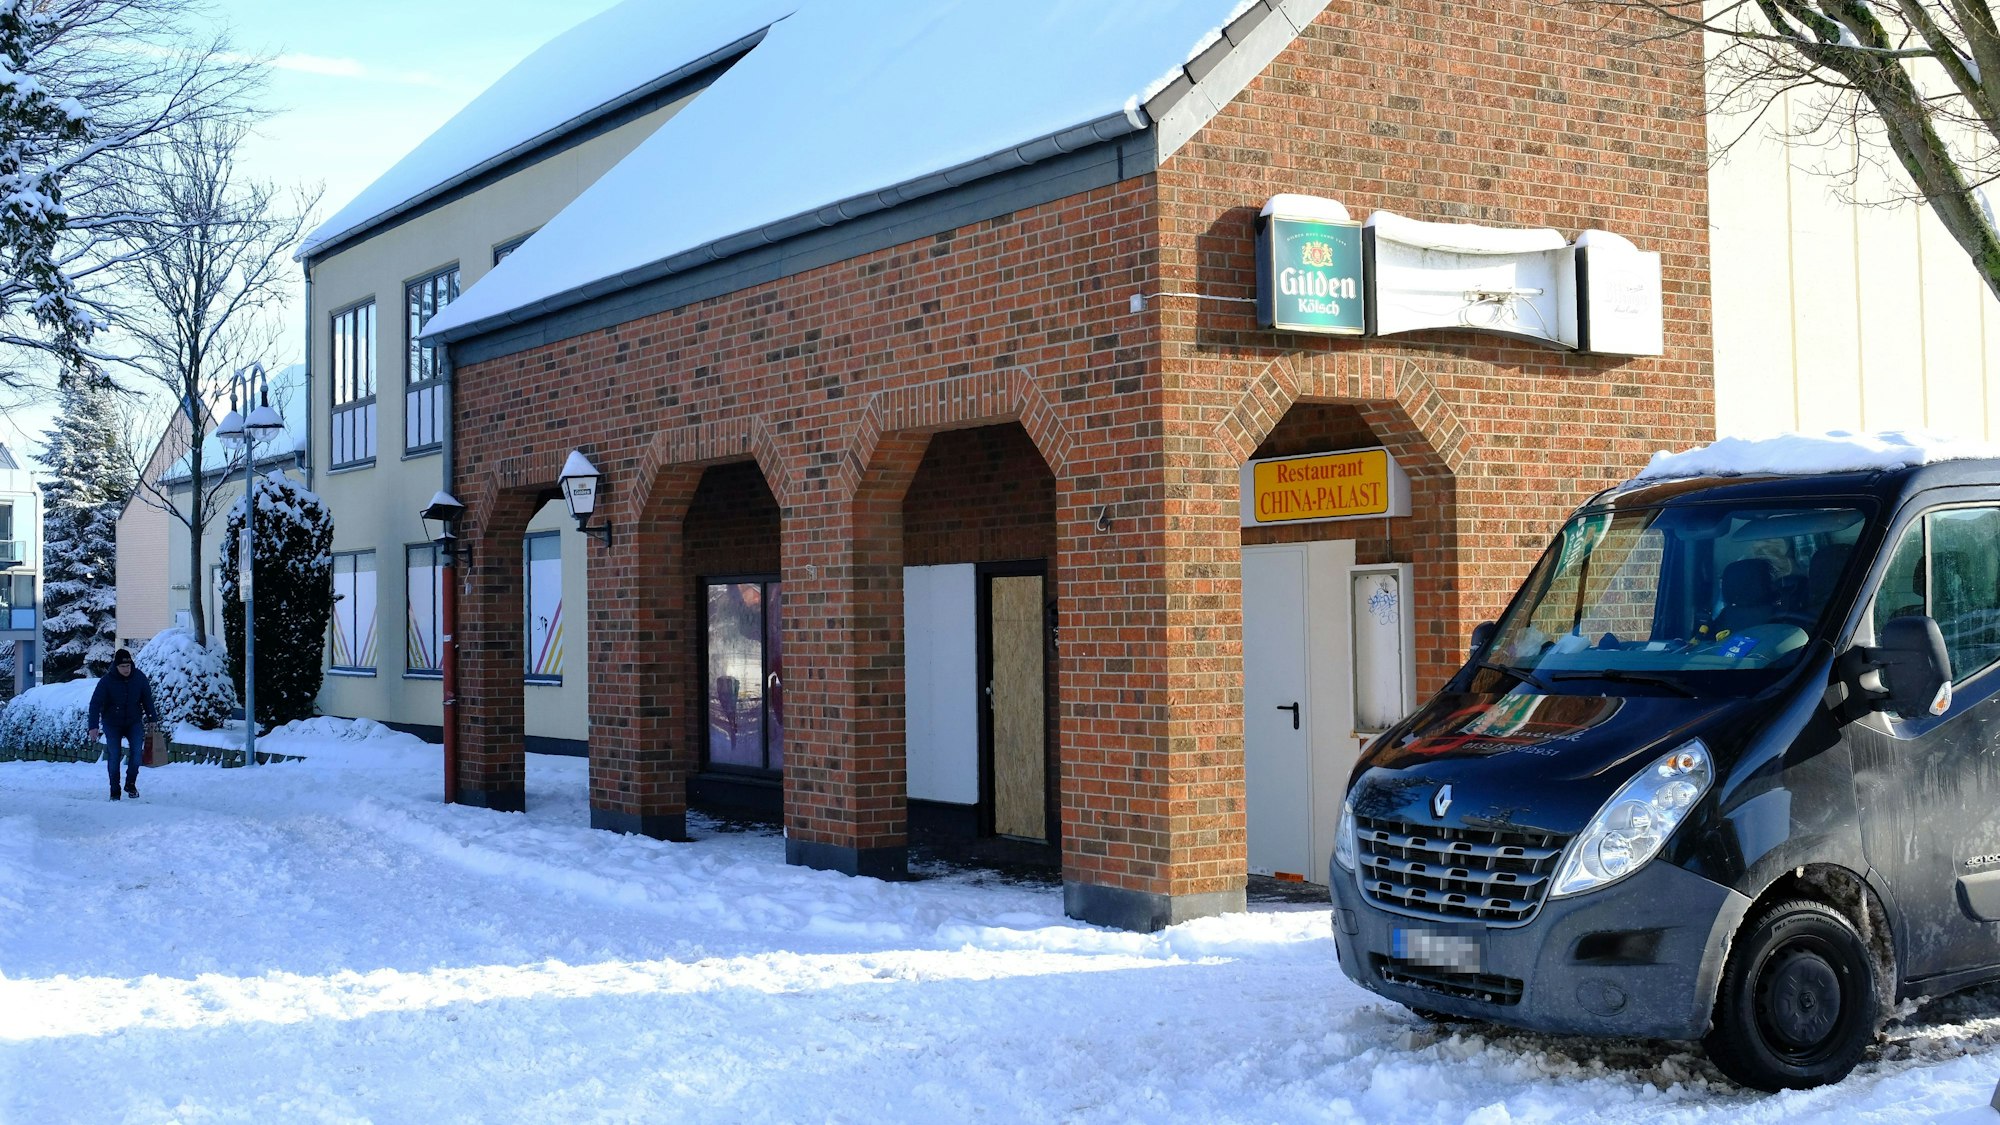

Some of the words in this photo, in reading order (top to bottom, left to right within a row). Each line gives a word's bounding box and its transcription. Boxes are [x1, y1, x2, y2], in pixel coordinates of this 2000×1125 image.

[1280, 267, 1356, 299] Gilden
[1298, 298, 1340, 316] Kölsch
[1276, 456, 1364, 484] Restaurant
[1260, 481, 1381, 516] CHINA-PALAST
